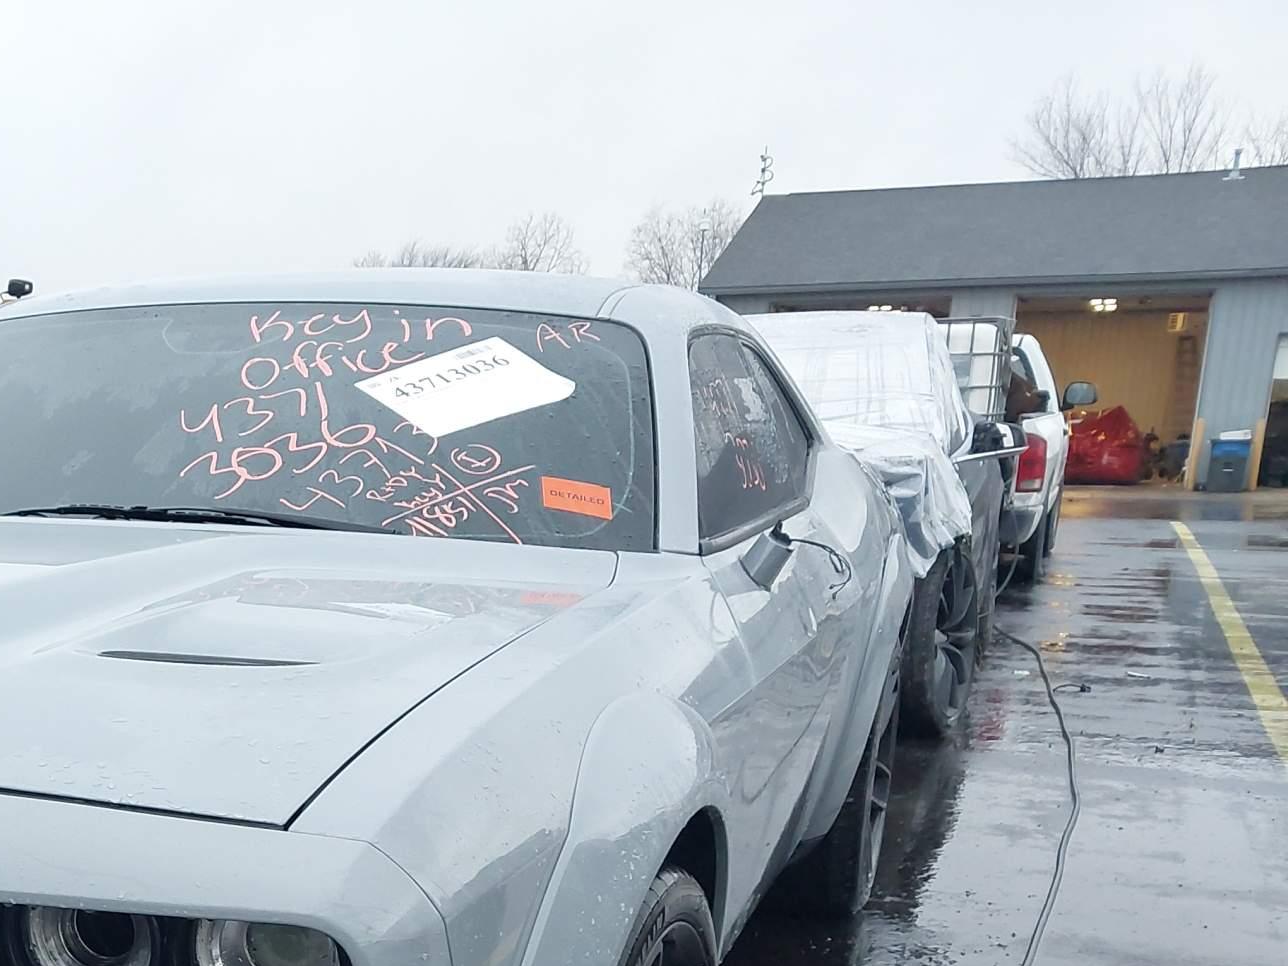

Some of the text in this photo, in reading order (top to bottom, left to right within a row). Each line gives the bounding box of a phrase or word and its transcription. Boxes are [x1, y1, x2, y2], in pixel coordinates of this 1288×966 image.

[393, 310, 472, 342] in
[536, 323, 601, 353] AR
[241, 340, 425, 390] Office
[395, 354, 510, 399] 43713036
[181, 381, 328, 442] 4371
[180, 420, 377, 500] 3036
[549, 489, 605, 505] DETAILED
